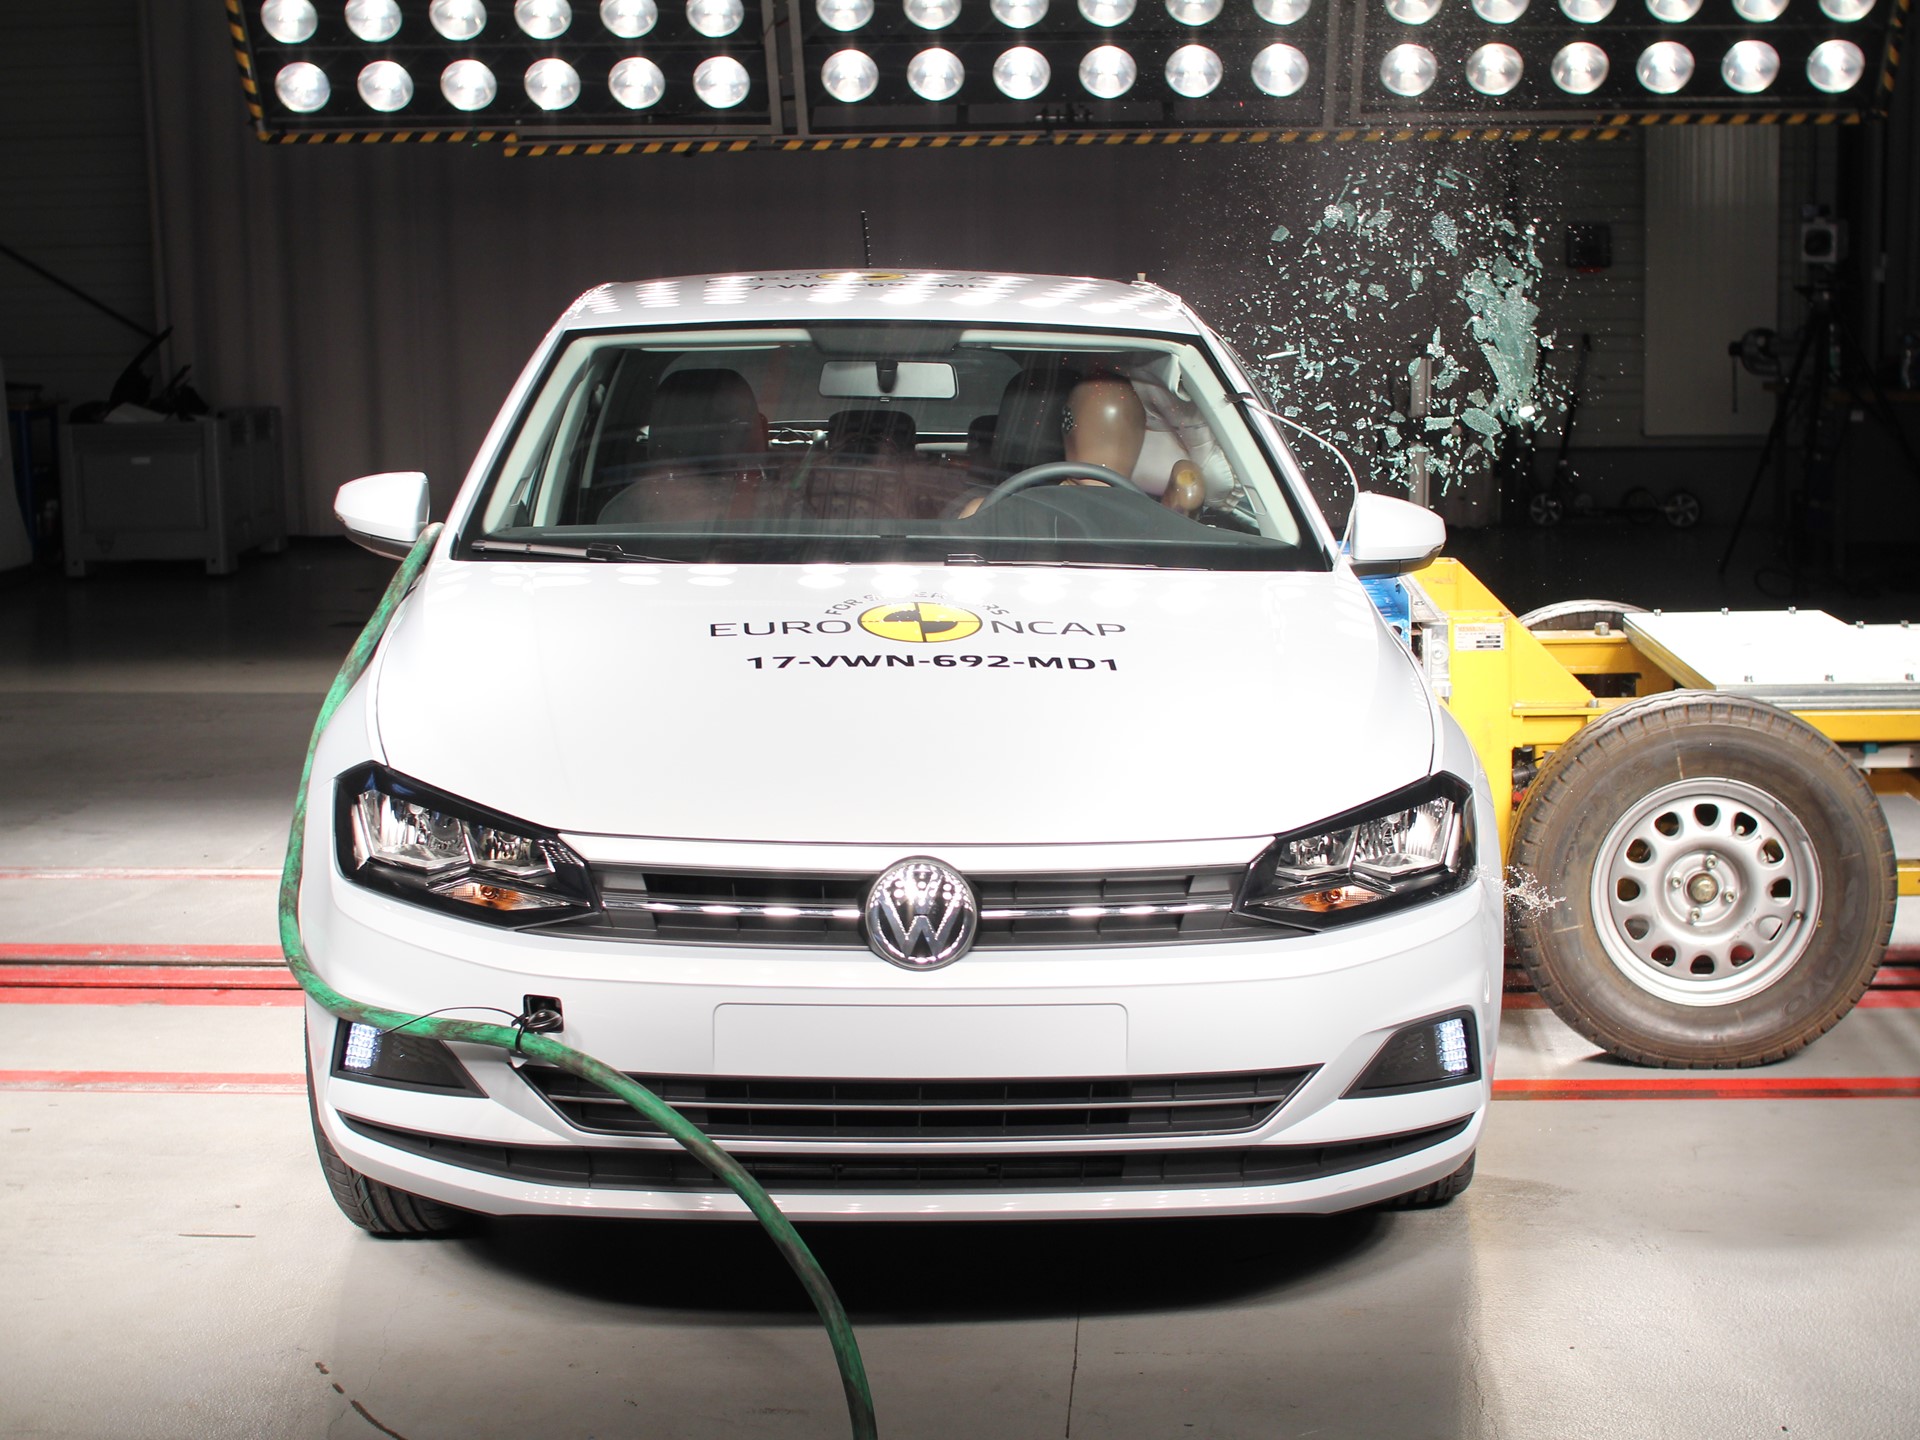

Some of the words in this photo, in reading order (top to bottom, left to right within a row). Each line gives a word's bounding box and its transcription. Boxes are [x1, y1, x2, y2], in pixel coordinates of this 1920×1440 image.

[825, 599, 863, 615] FOR
[709, 620, 852, 637] EURO
[990, 620, 1127, 637] NCAP
[747, 654, 1118, 671] 17-VWN-692-MD1
[870, 861, 972, 965] VW
